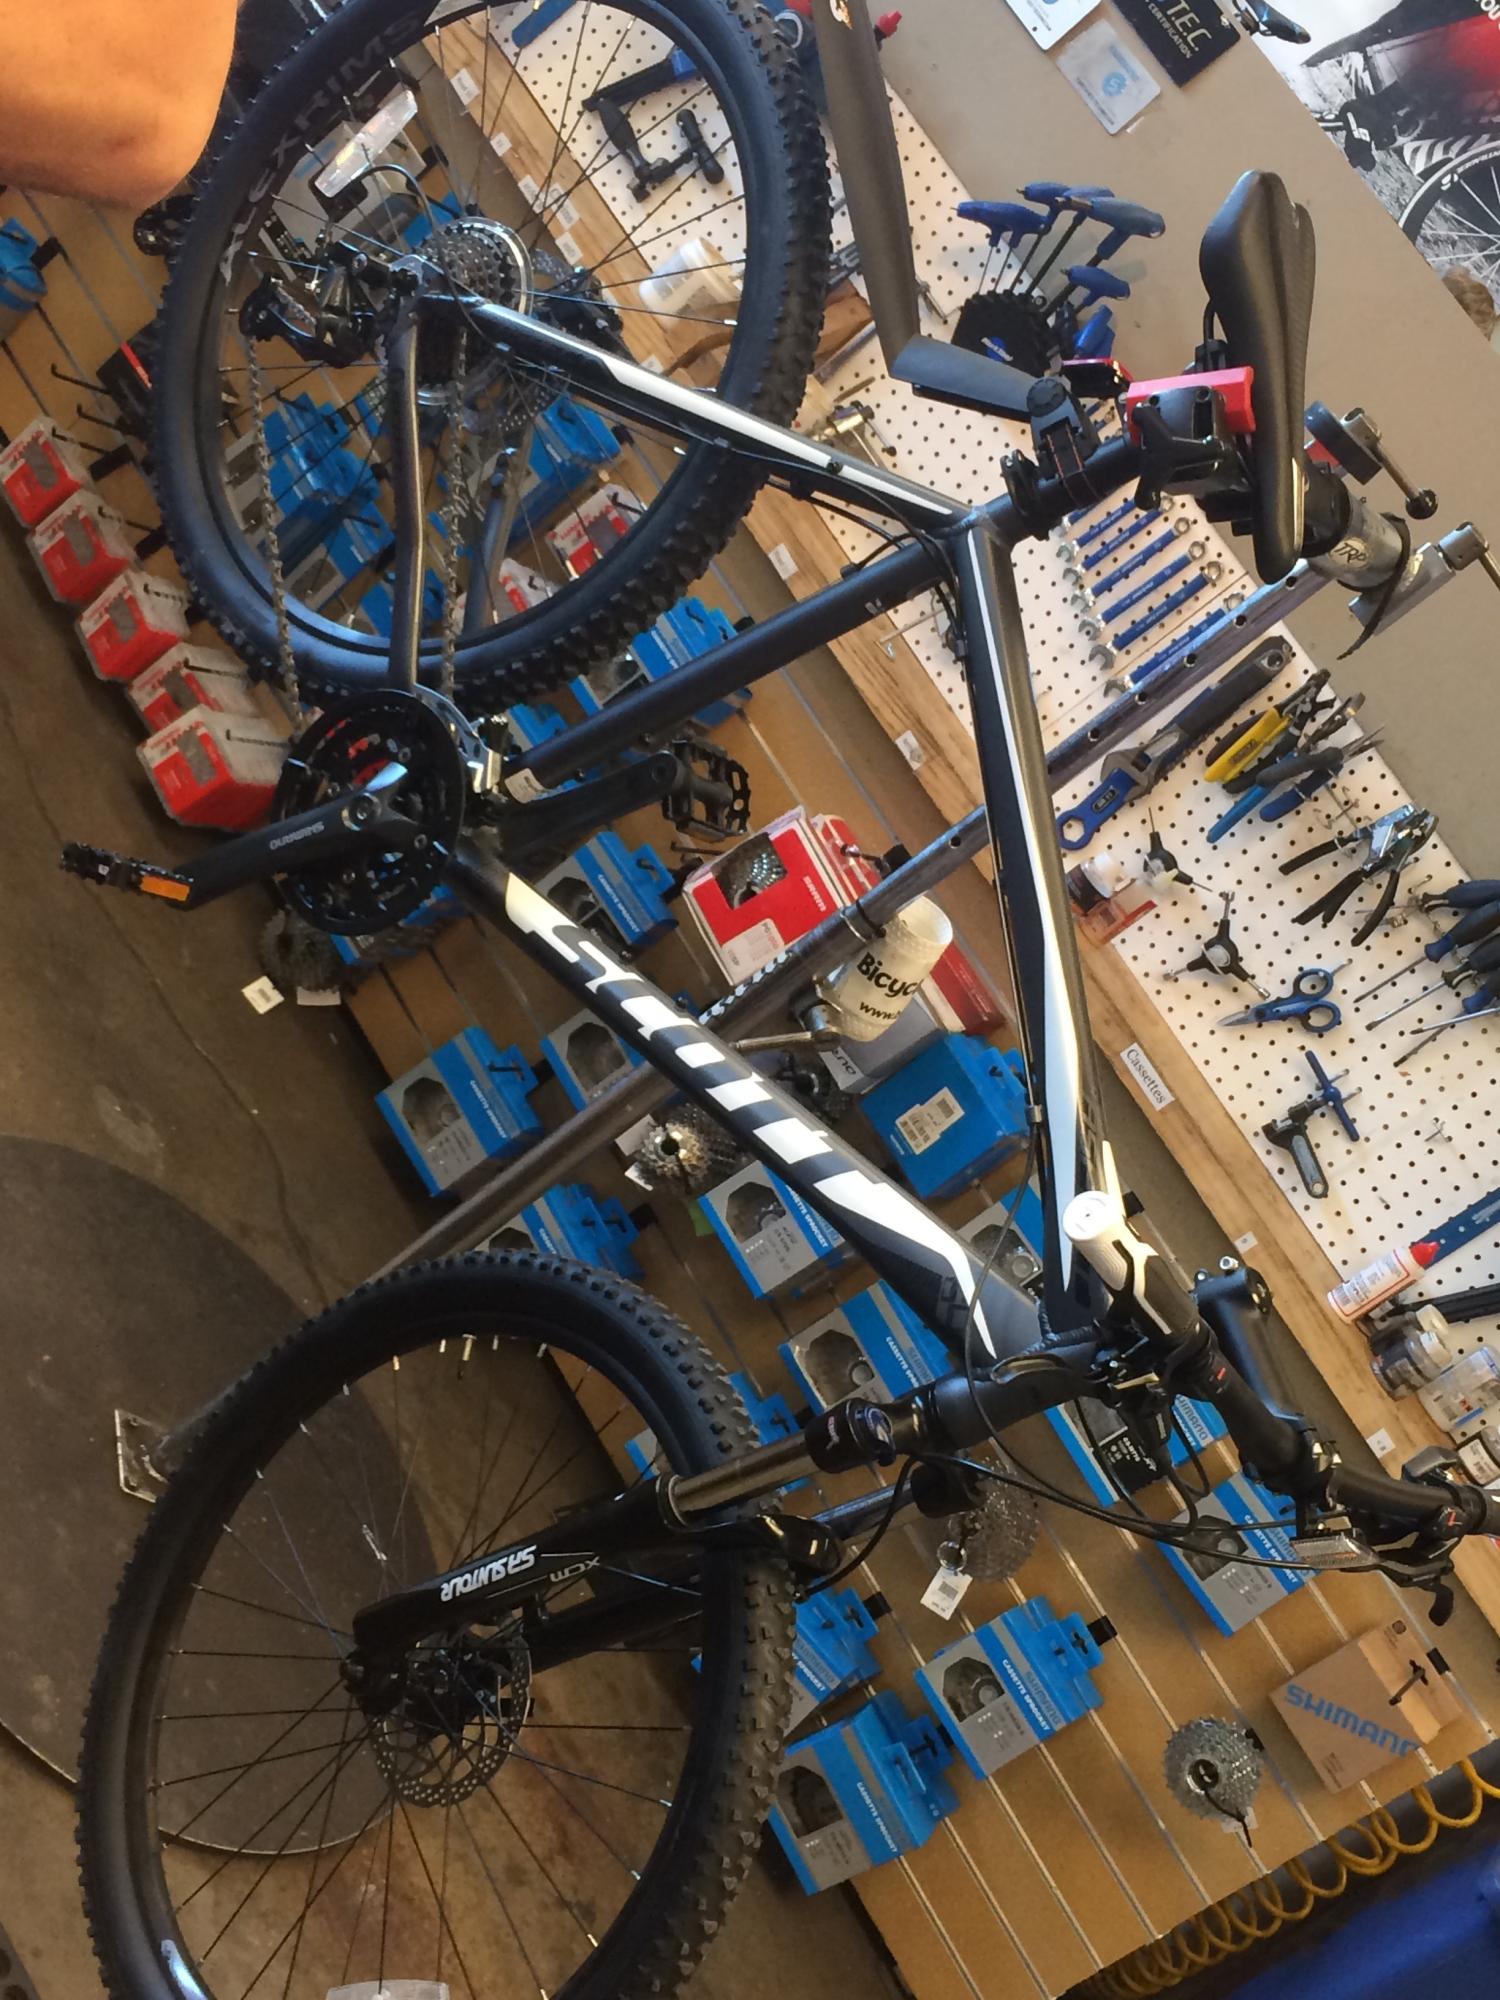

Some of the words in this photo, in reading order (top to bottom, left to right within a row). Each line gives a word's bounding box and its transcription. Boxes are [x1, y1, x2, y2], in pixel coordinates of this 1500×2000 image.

[1148, 3, 1192, 59] CERTIFICATION
[802, 875, 828, 912] SRAM
[857, 951, 923, 998] Bicyc
[1126, 1048, 1166, 1104] Cassettes
[804, 1213, 829, 1248] SPROCKET
[885, 1336, 909, 1370] CASSETTE
[440, 1556, 508, 1602] SUNTOUR
[1002, 1658, 1027, 1697] CASSETTE
[1023, 1694, 1051, 1731] SPROCKET
